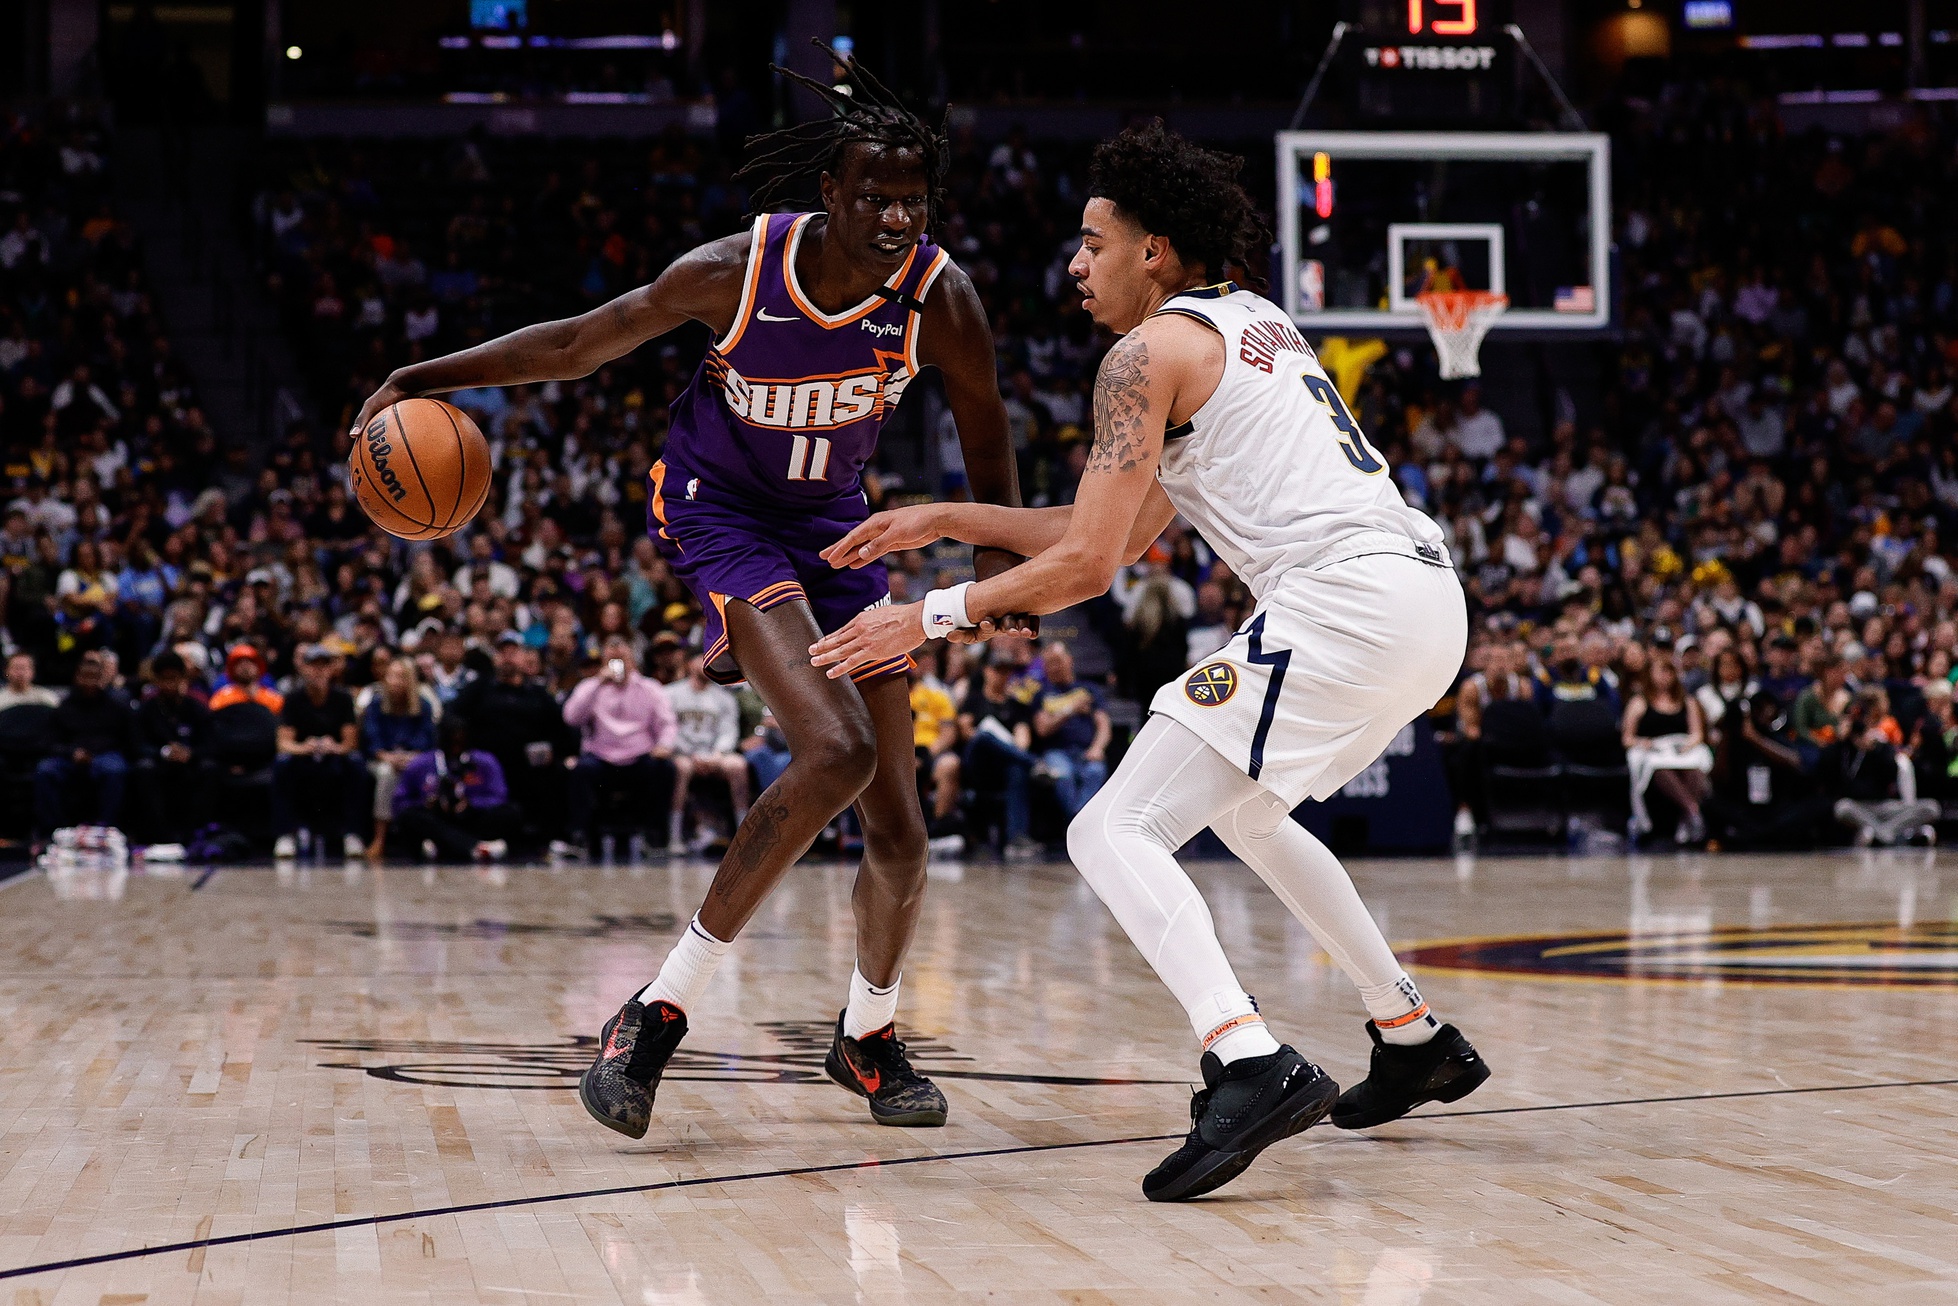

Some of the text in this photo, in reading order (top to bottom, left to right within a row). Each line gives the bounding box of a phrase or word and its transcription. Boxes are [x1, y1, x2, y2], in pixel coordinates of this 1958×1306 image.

[1399, 46, 1496, 69] TISSOT
[861, 319, 903, 338] PayPal
[1300, 372, 1386, 476] 3
[367, 415, 408, 503] Wilson
[787, 434, 831, 481] 11
